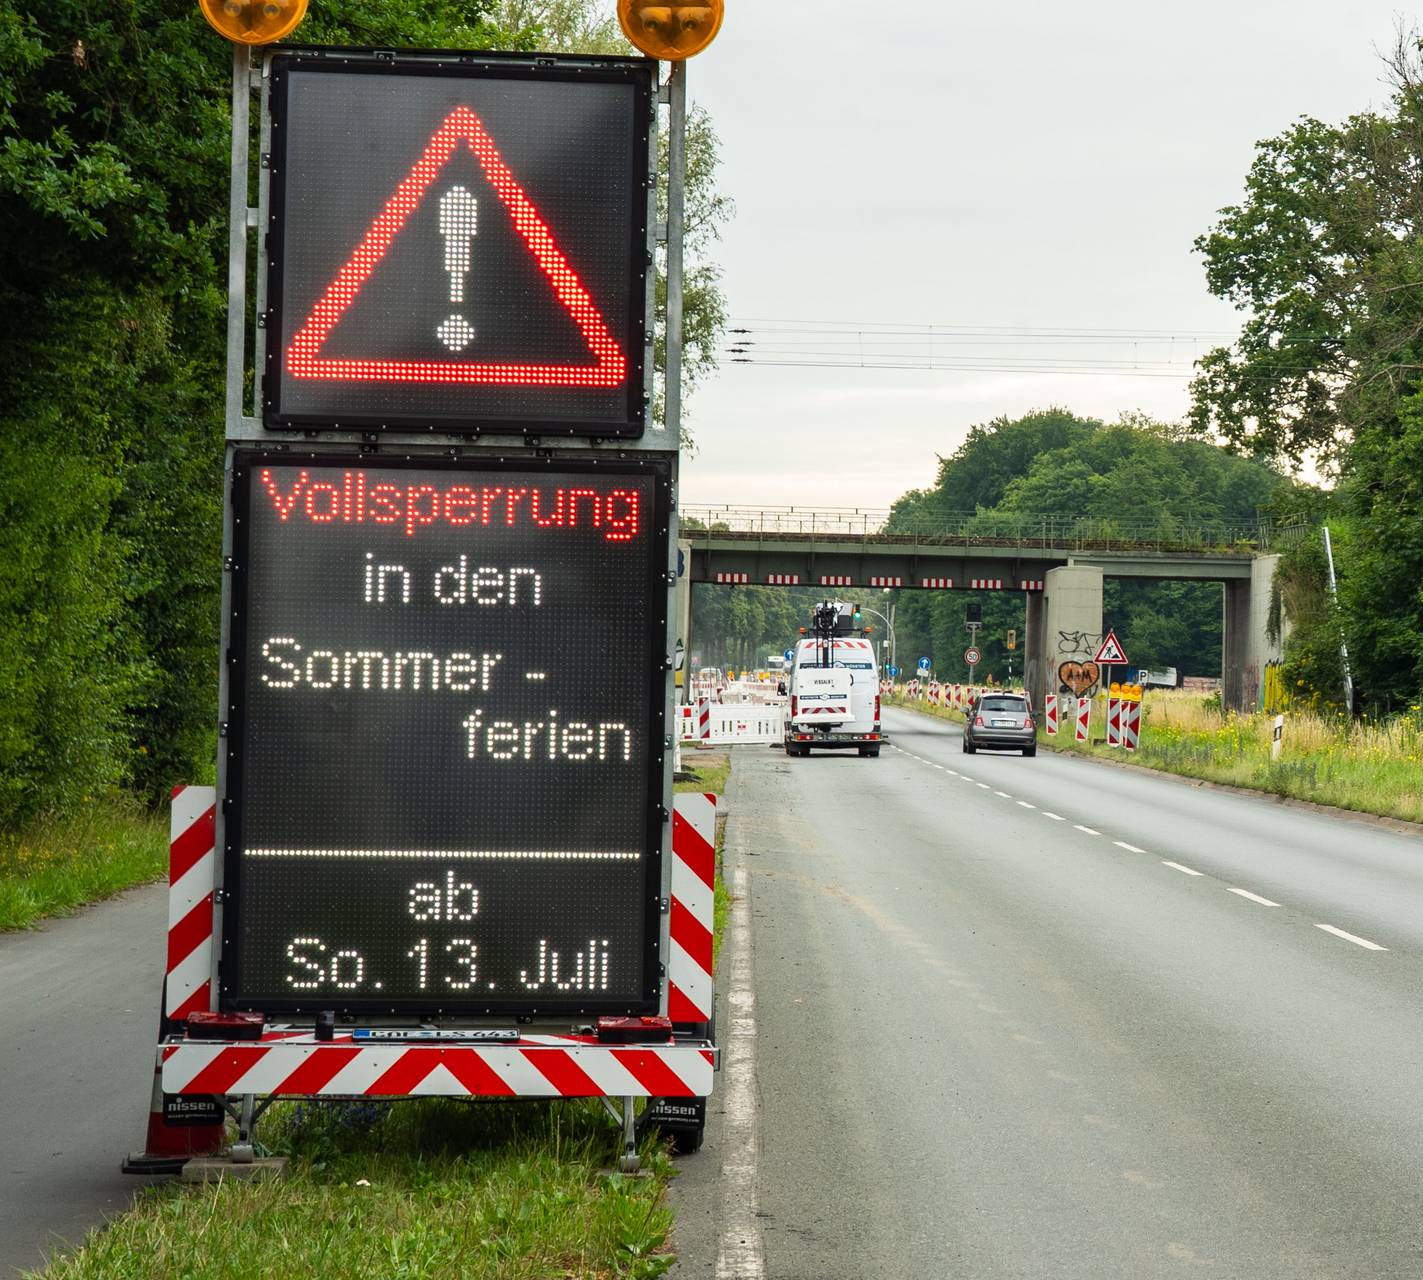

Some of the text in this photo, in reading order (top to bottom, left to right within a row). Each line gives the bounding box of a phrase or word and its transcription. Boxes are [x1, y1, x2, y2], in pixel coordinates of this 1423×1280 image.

[262, 469, 640, 541] Vollsperrung
[365, 552, 542, 606] in den
[261, 637, 503, 692] Sommer
[968, 653, 977, 661] 50
[1140, 671, 1147, 681] P
[462, 709, 631, 760] ferien
[409, 870, 480, 921] ab
[286, 937, 609, 990] So. 13. Juli
[168, 1097, 215, 1111] nissen
